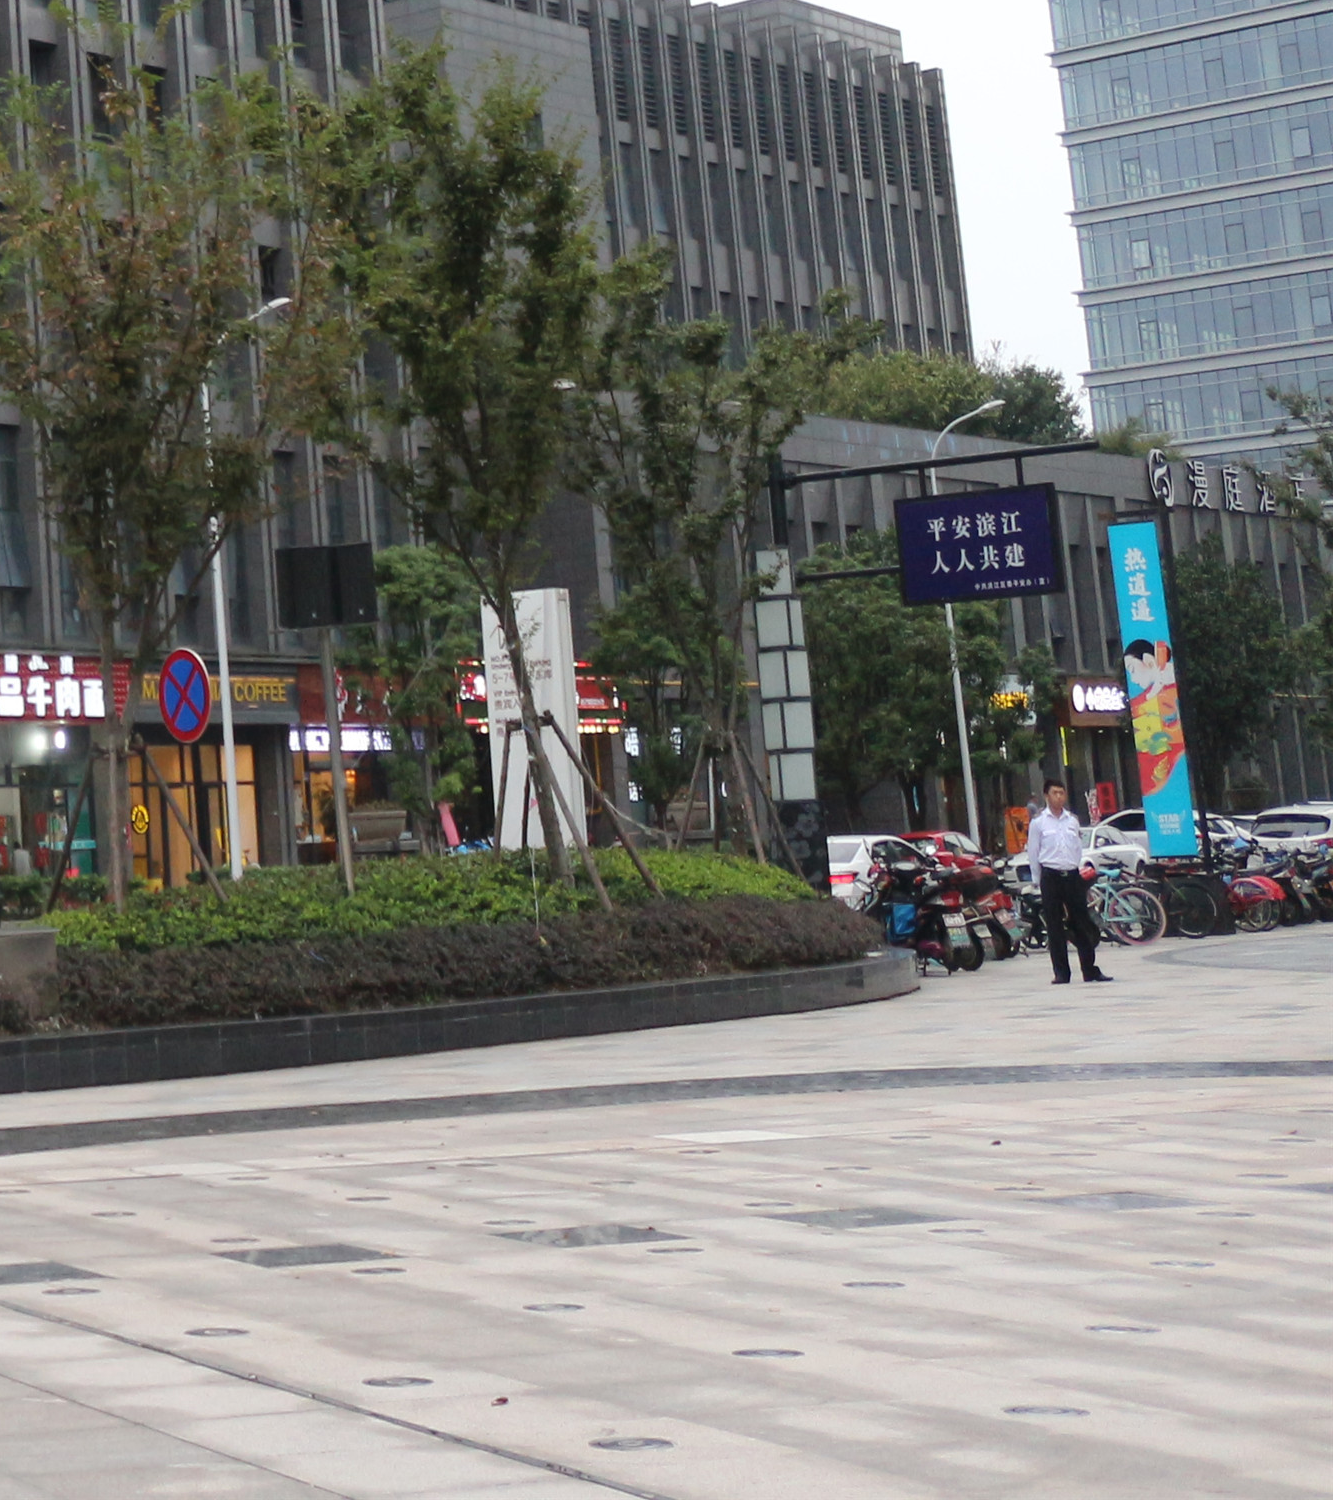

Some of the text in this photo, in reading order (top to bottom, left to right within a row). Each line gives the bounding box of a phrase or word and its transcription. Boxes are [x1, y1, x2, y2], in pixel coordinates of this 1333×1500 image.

[927, 511, 1023, 542] 平安滨江
[931, 543, 1026, 575] 人人共建
[1124, 547, 1155, 621] 热逍遥
[234, 682, 288, 702] COFFEE
